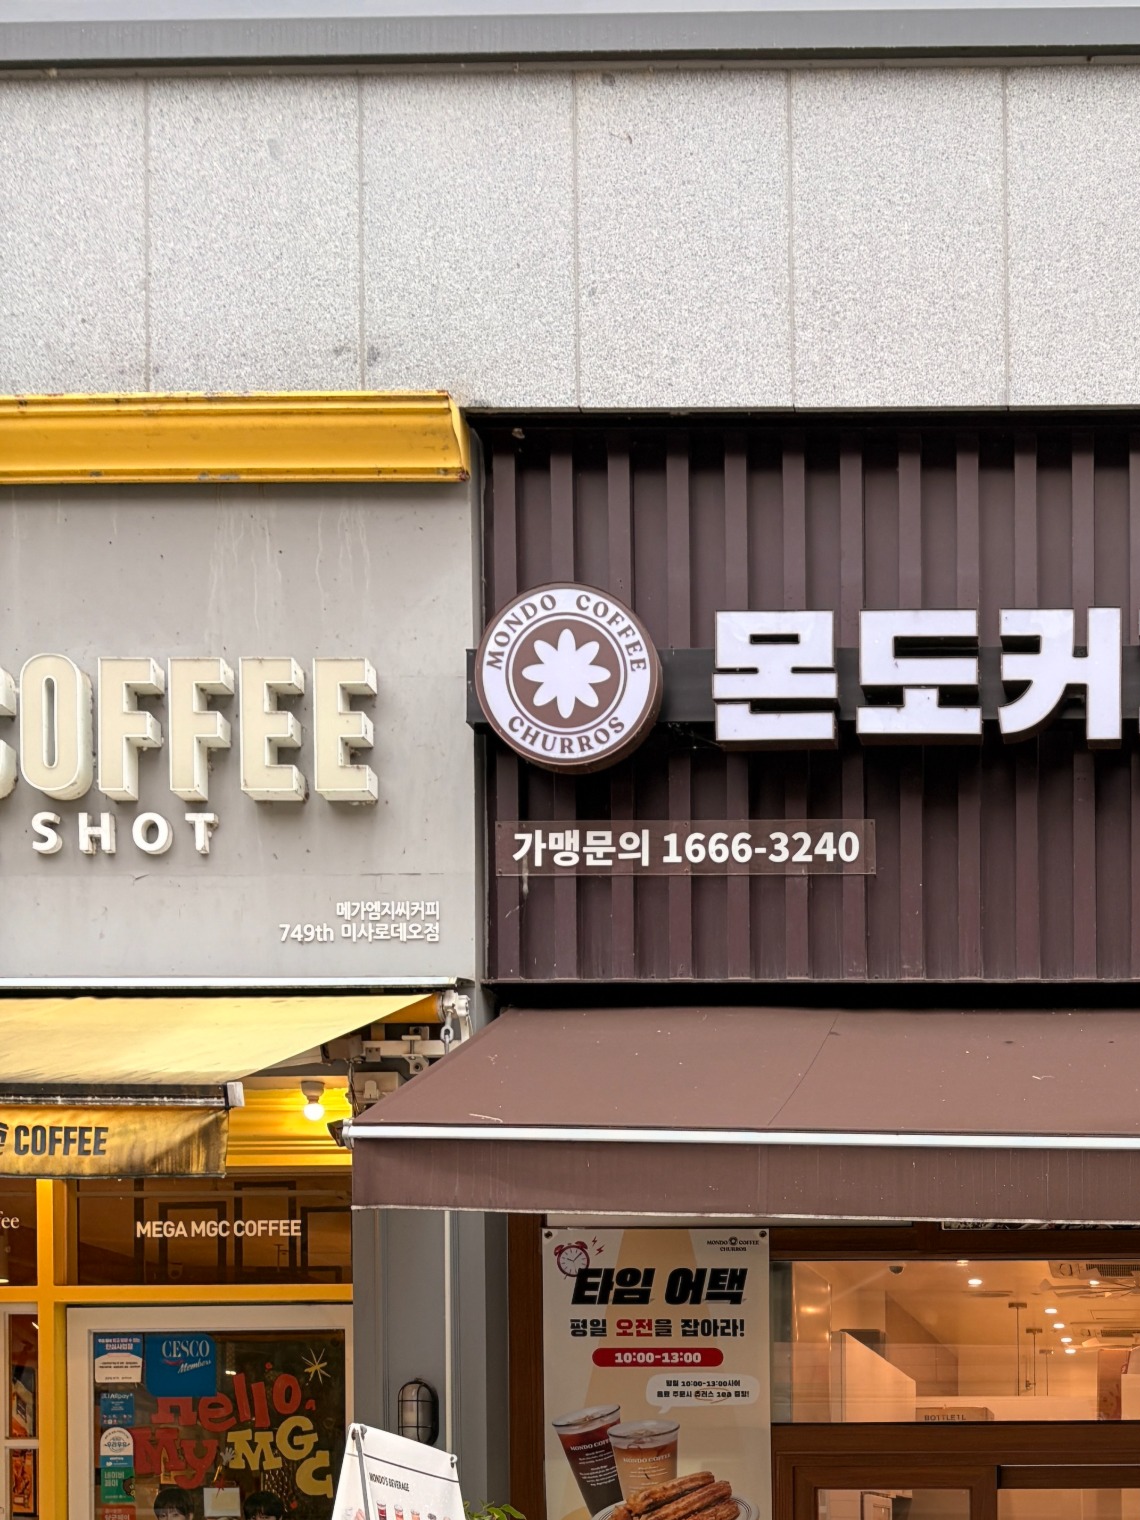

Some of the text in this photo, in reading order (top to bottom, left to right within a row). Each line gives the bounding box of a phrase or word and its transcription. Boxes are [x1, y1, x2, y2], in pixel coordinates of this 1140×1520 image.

[486, 593, 648, 672] MONDO COFFEE
[0, 652, 379, 802] OFFEE
[508, 716, 625, 755] CHURROS
[31, 812, 219, 856] SHOT
[512, 830, 860, 867] 가맹문의 1666-3240
[336, 901, 441, 921] 메가엠지씨커피
[279, 922, 441, 943] 749th 미사로데오점
[14, 1125, 109, 1156] COFFEE
[0, 1211, 20, 1229] ee
[136, 1219, 302, 1238] MEGA MGC COFFEE
[571, 1267, 749, 1306] 타임 어택
[570, 1318, 745, 1337] 평일 오전을 잡아라!
[162, 1339, 210, 1358] CESCO
[614, 1352, 702, 1364] 10:00-13:00
[178, 1358, 212, 1374] Members
